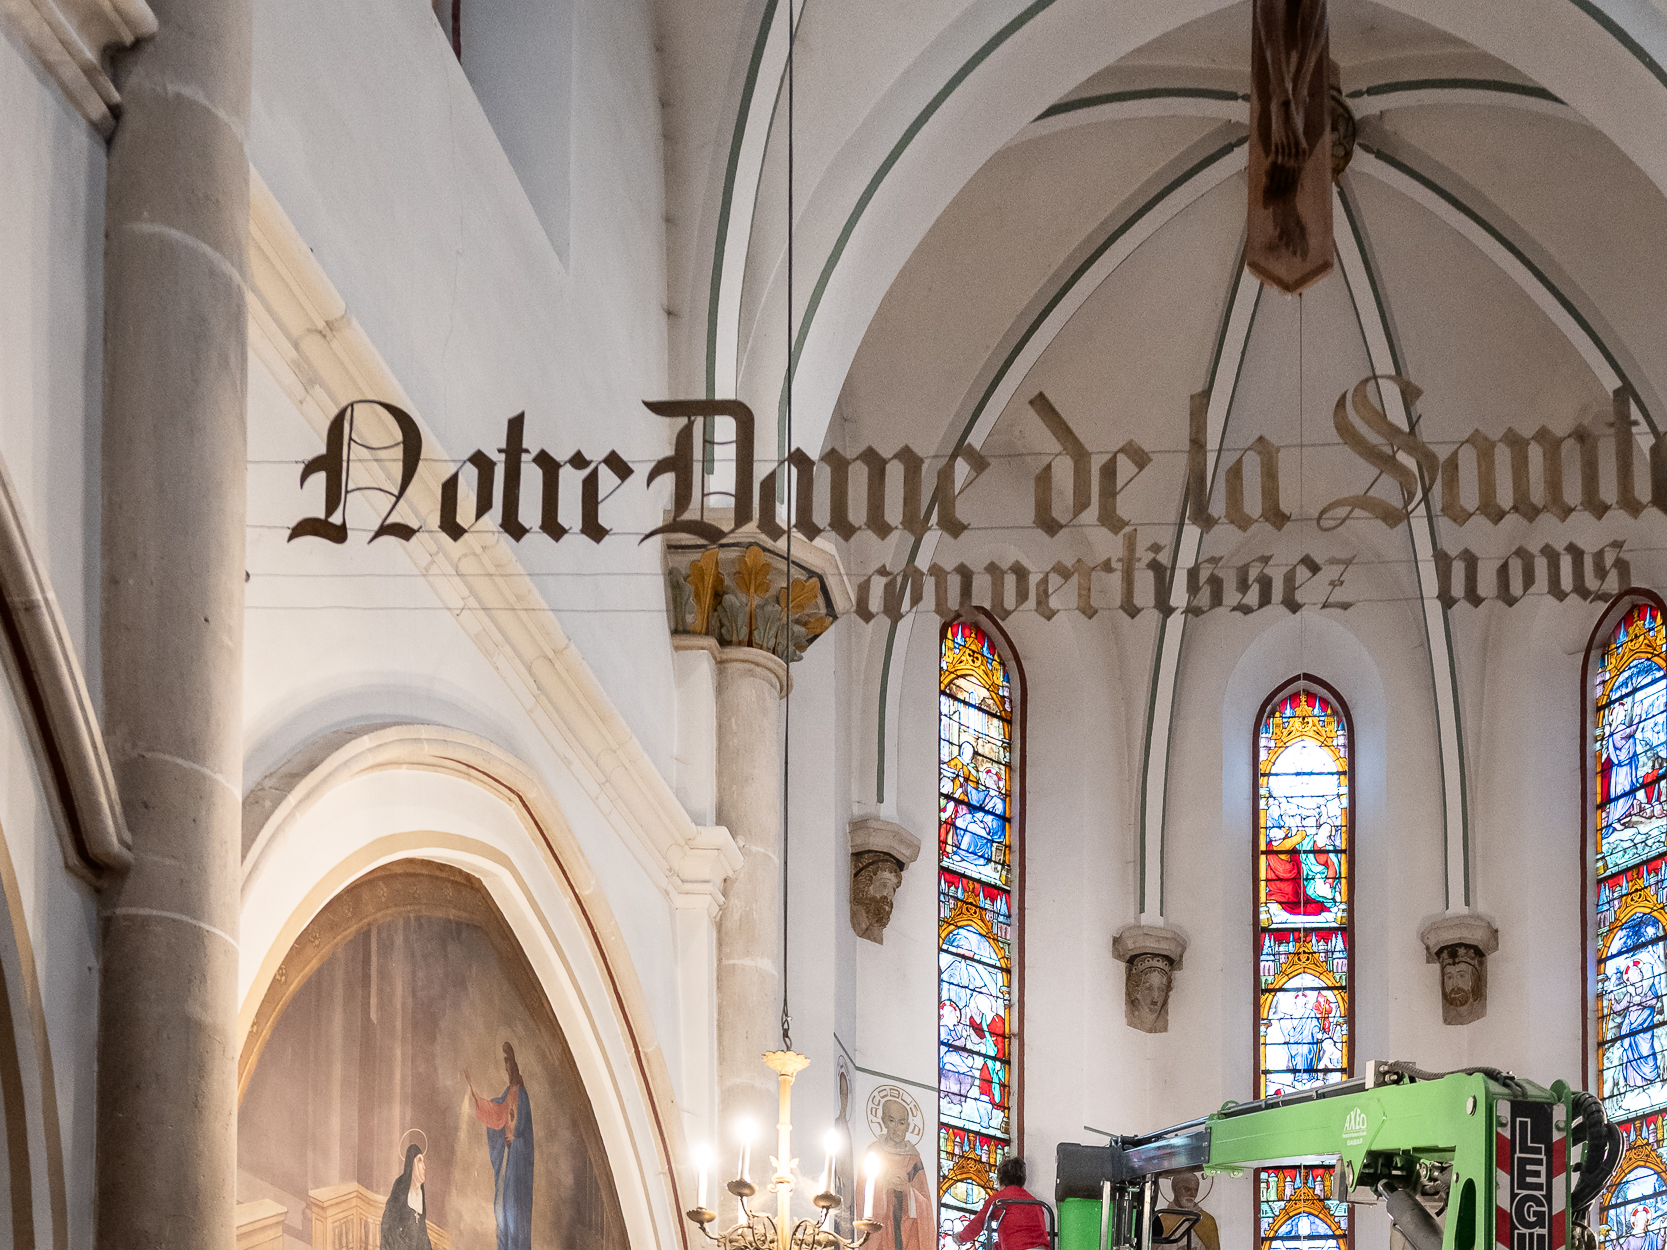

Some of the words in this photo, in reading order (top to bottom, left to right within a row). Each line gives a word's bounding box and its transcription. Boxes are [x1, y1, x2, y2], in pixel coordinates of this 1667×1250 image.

[287, 400, 634, 545] Notre
[638, 400, 989, 545] Dame
[1029, 391, 1152, 540] de
[1187, 389, 1292, 531] la
[1432, 539, 1632, 610] nous
